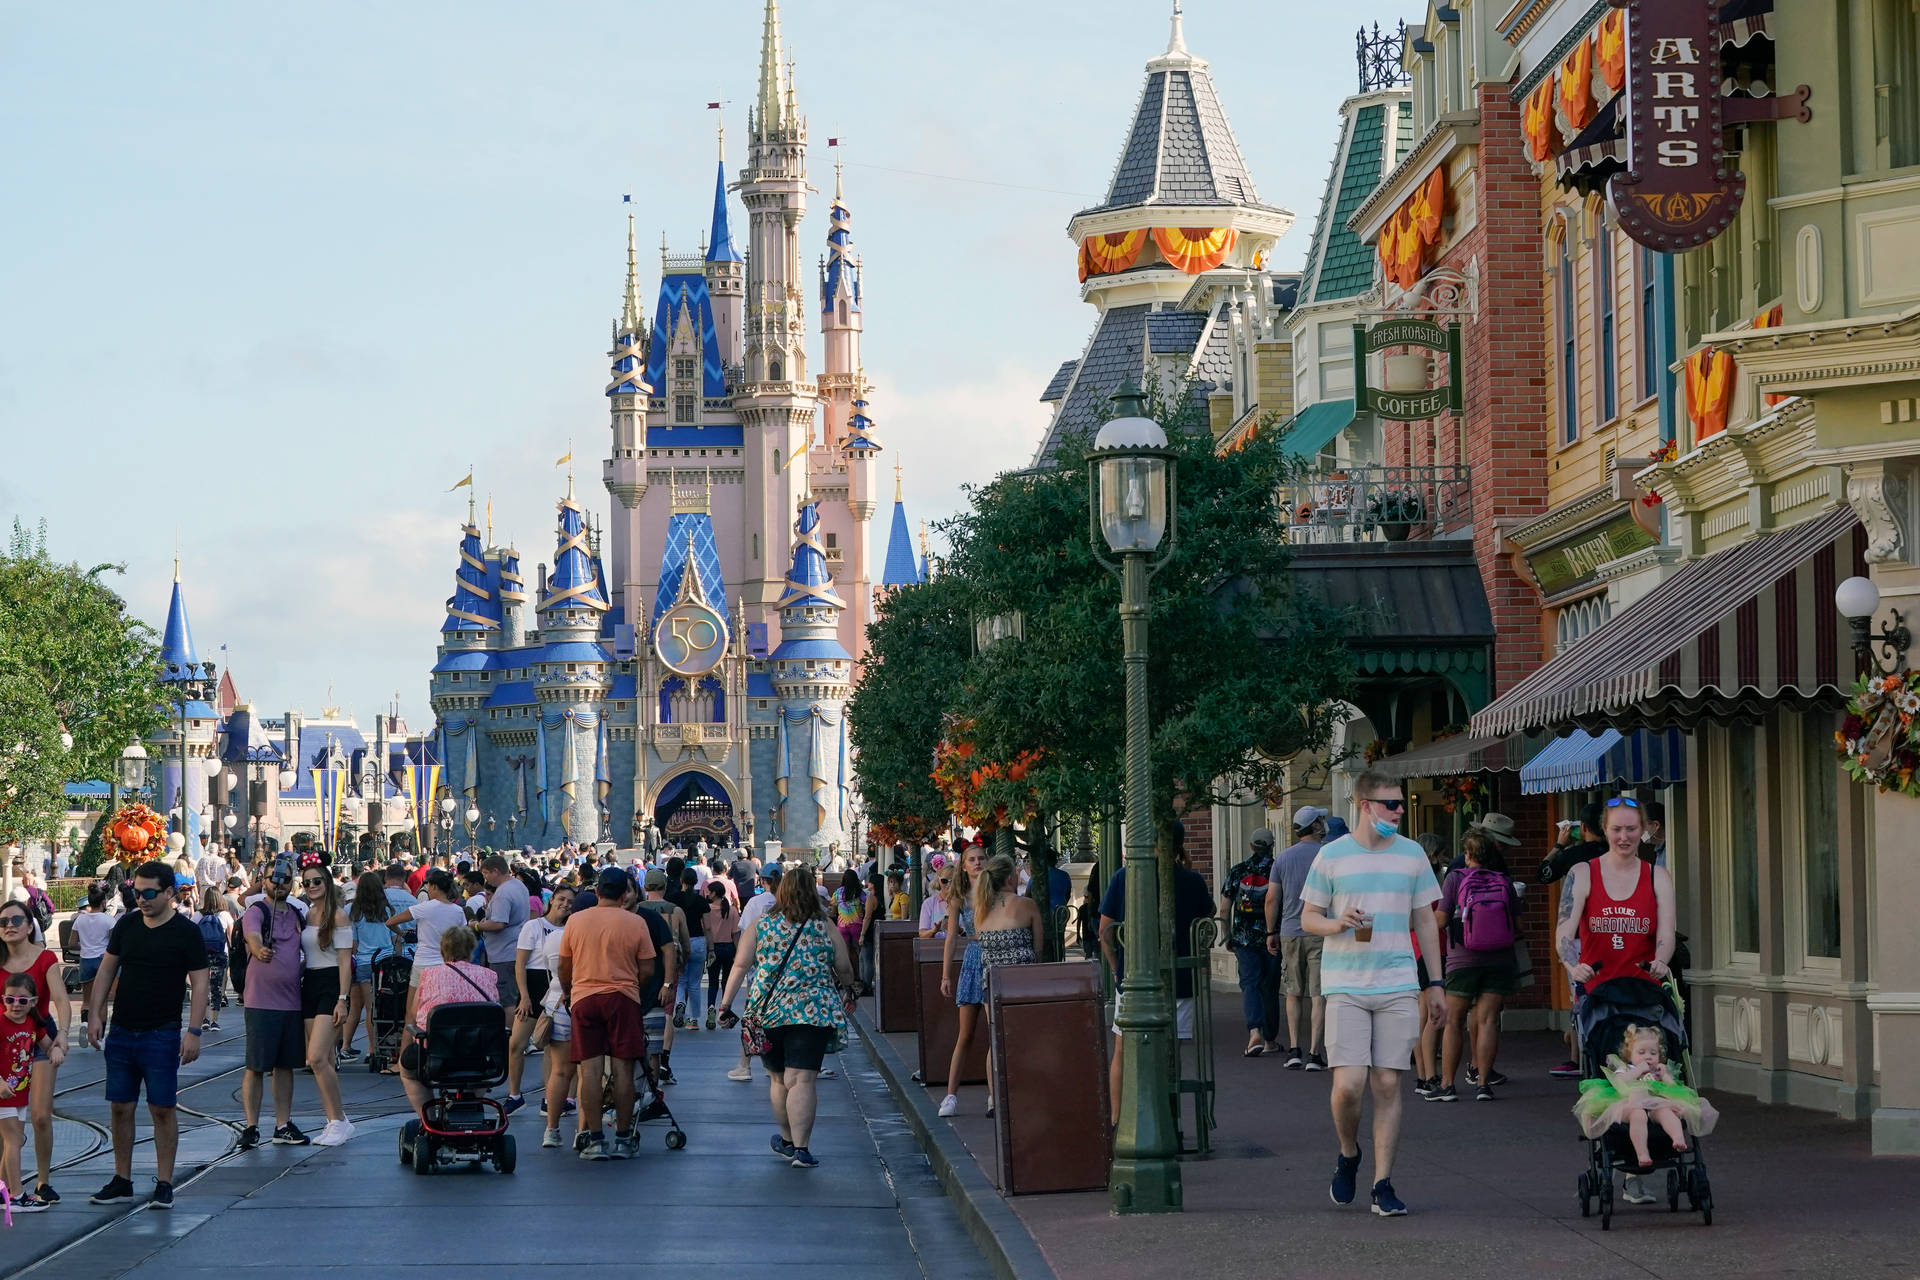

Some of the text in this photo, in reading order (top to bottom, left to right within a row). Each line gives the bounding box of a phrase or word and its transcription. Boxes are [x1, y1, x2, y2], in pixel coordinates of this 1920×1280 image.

[1650, 37, 1700, 168] ARTS
[1373, 325, 1442, 347] FRESH ROASTED
[1377, 394, 1441, 415] COFFEE
[1562, 531, 1617, 578] BAKERY
[672, 617, 718, 667] 50
[1614, 906, 1635, 916] LOUIS
[1590, 917, 1650, 933] CARDINALS
